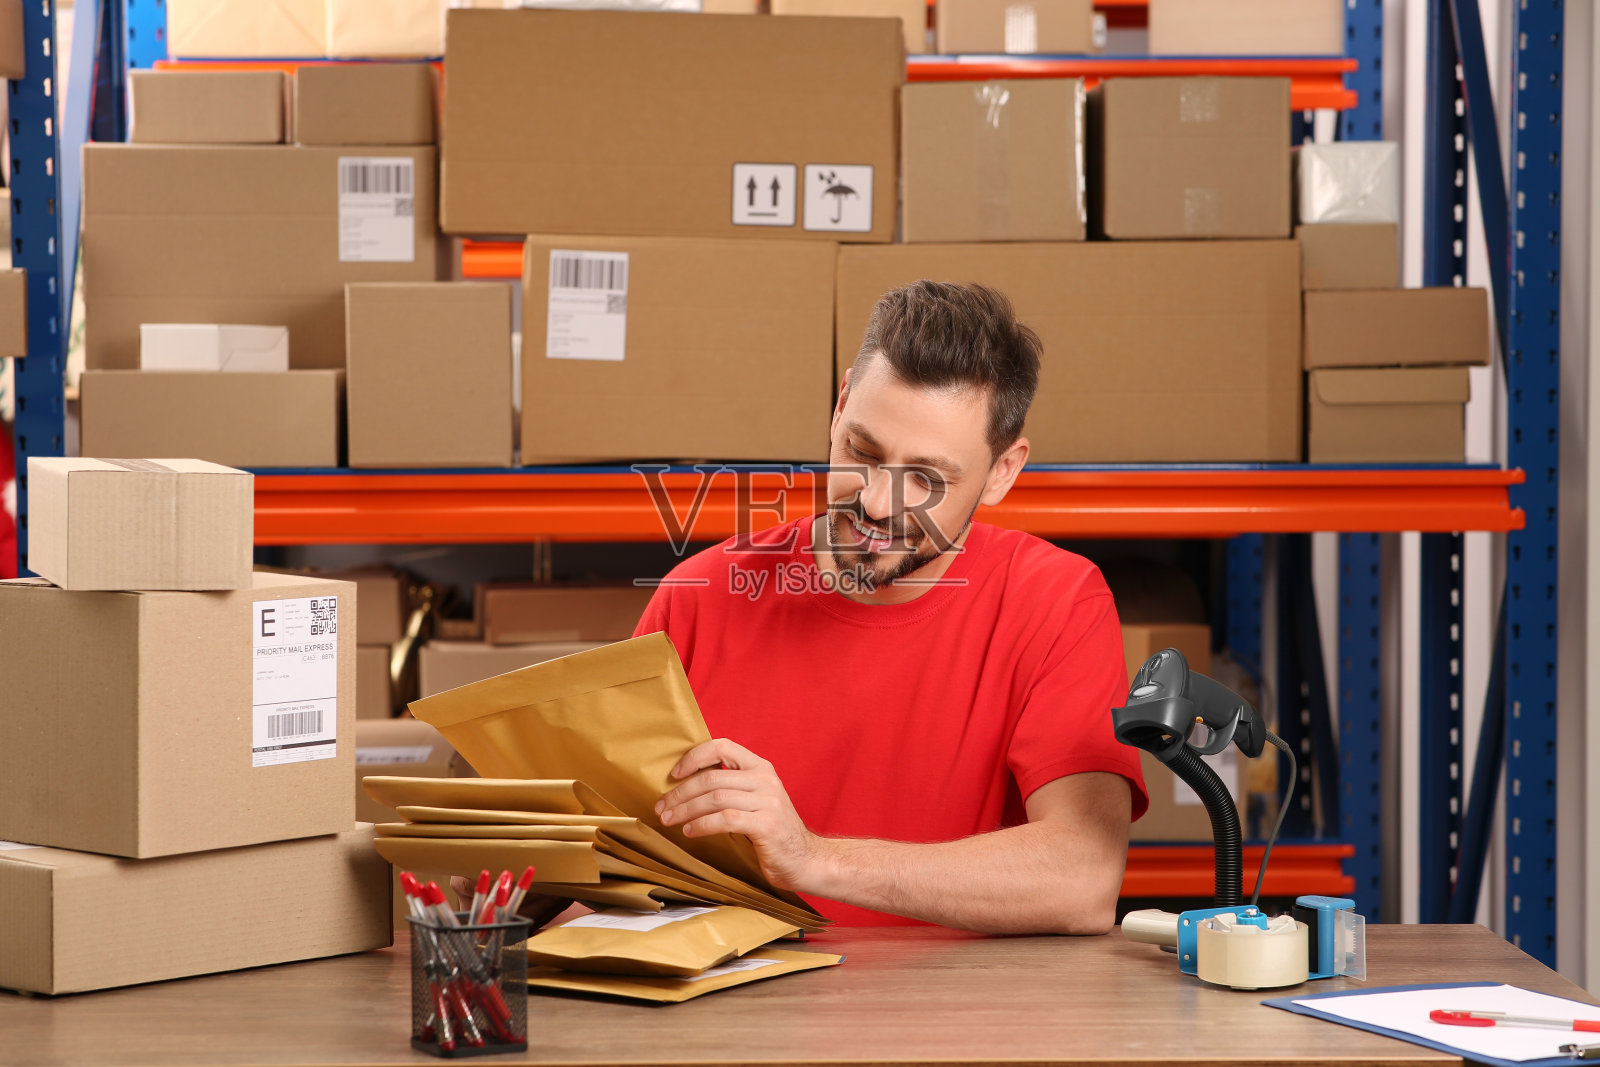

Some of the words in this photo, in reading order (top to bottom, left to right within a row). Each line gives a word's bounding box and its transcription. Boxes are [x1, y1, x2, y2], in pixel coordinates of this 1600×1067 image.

[262, 609, 275, 637] E
[257, 647, 286, 656] PRIORITY
[288, 646, 303, 654] MAIL
[305, 643, 333, 652] EXPRESS
